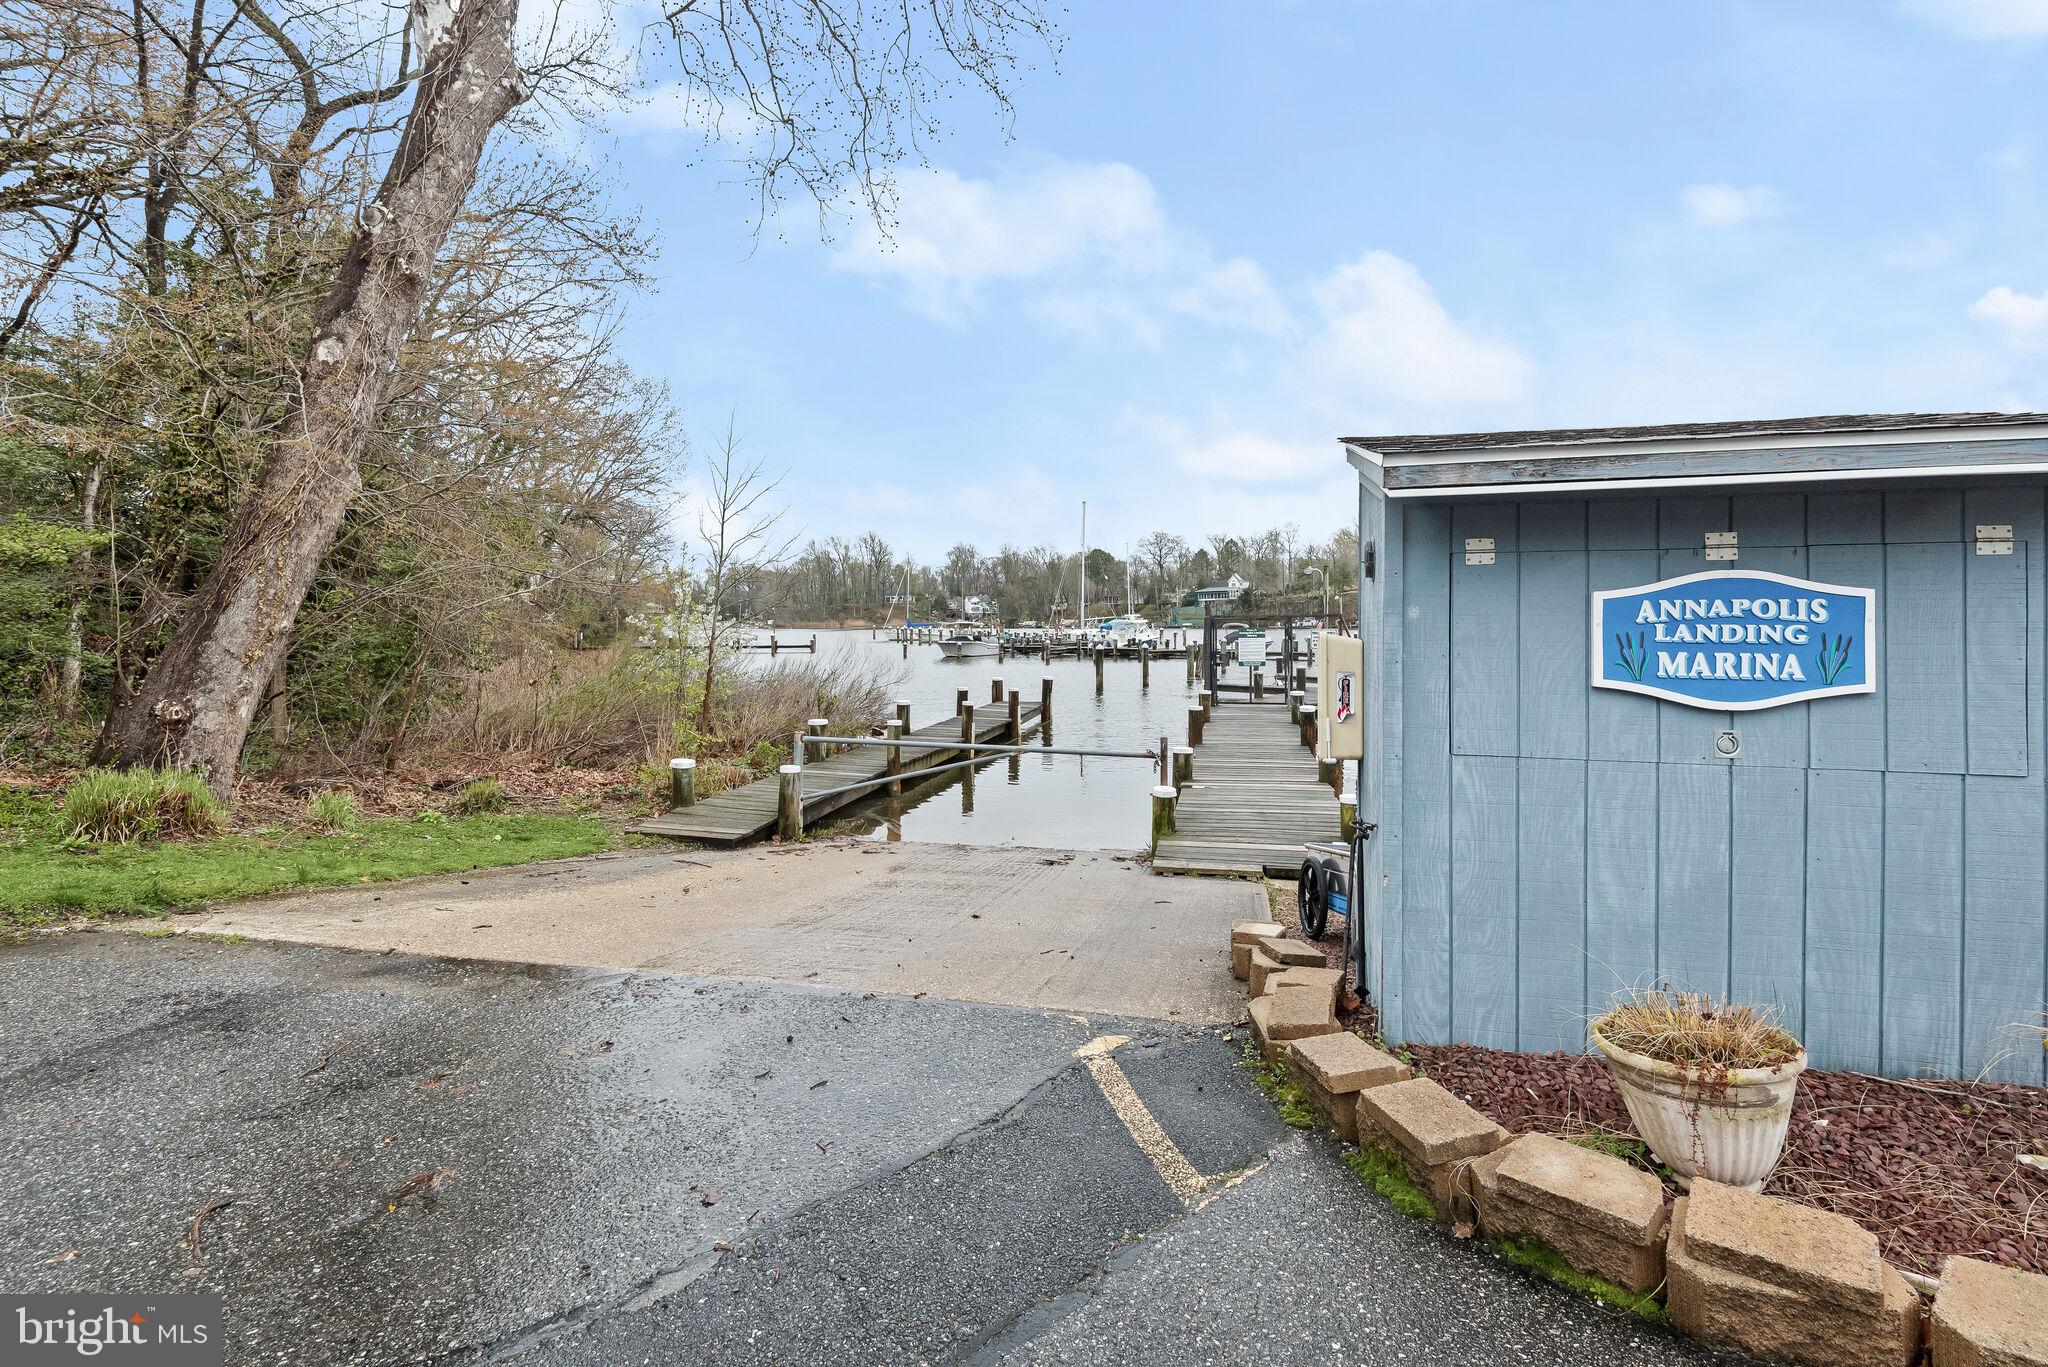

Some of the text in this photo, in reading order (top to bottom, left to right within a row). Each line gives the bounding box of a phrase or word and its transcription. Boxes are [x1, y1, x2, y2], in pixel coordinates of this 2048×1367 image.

[1635, 598, 1830, 624] ANNAPOLIS
[1654, 624, 1809, 645] LANDING
[1656, 652, 1807, 681] MARINA
